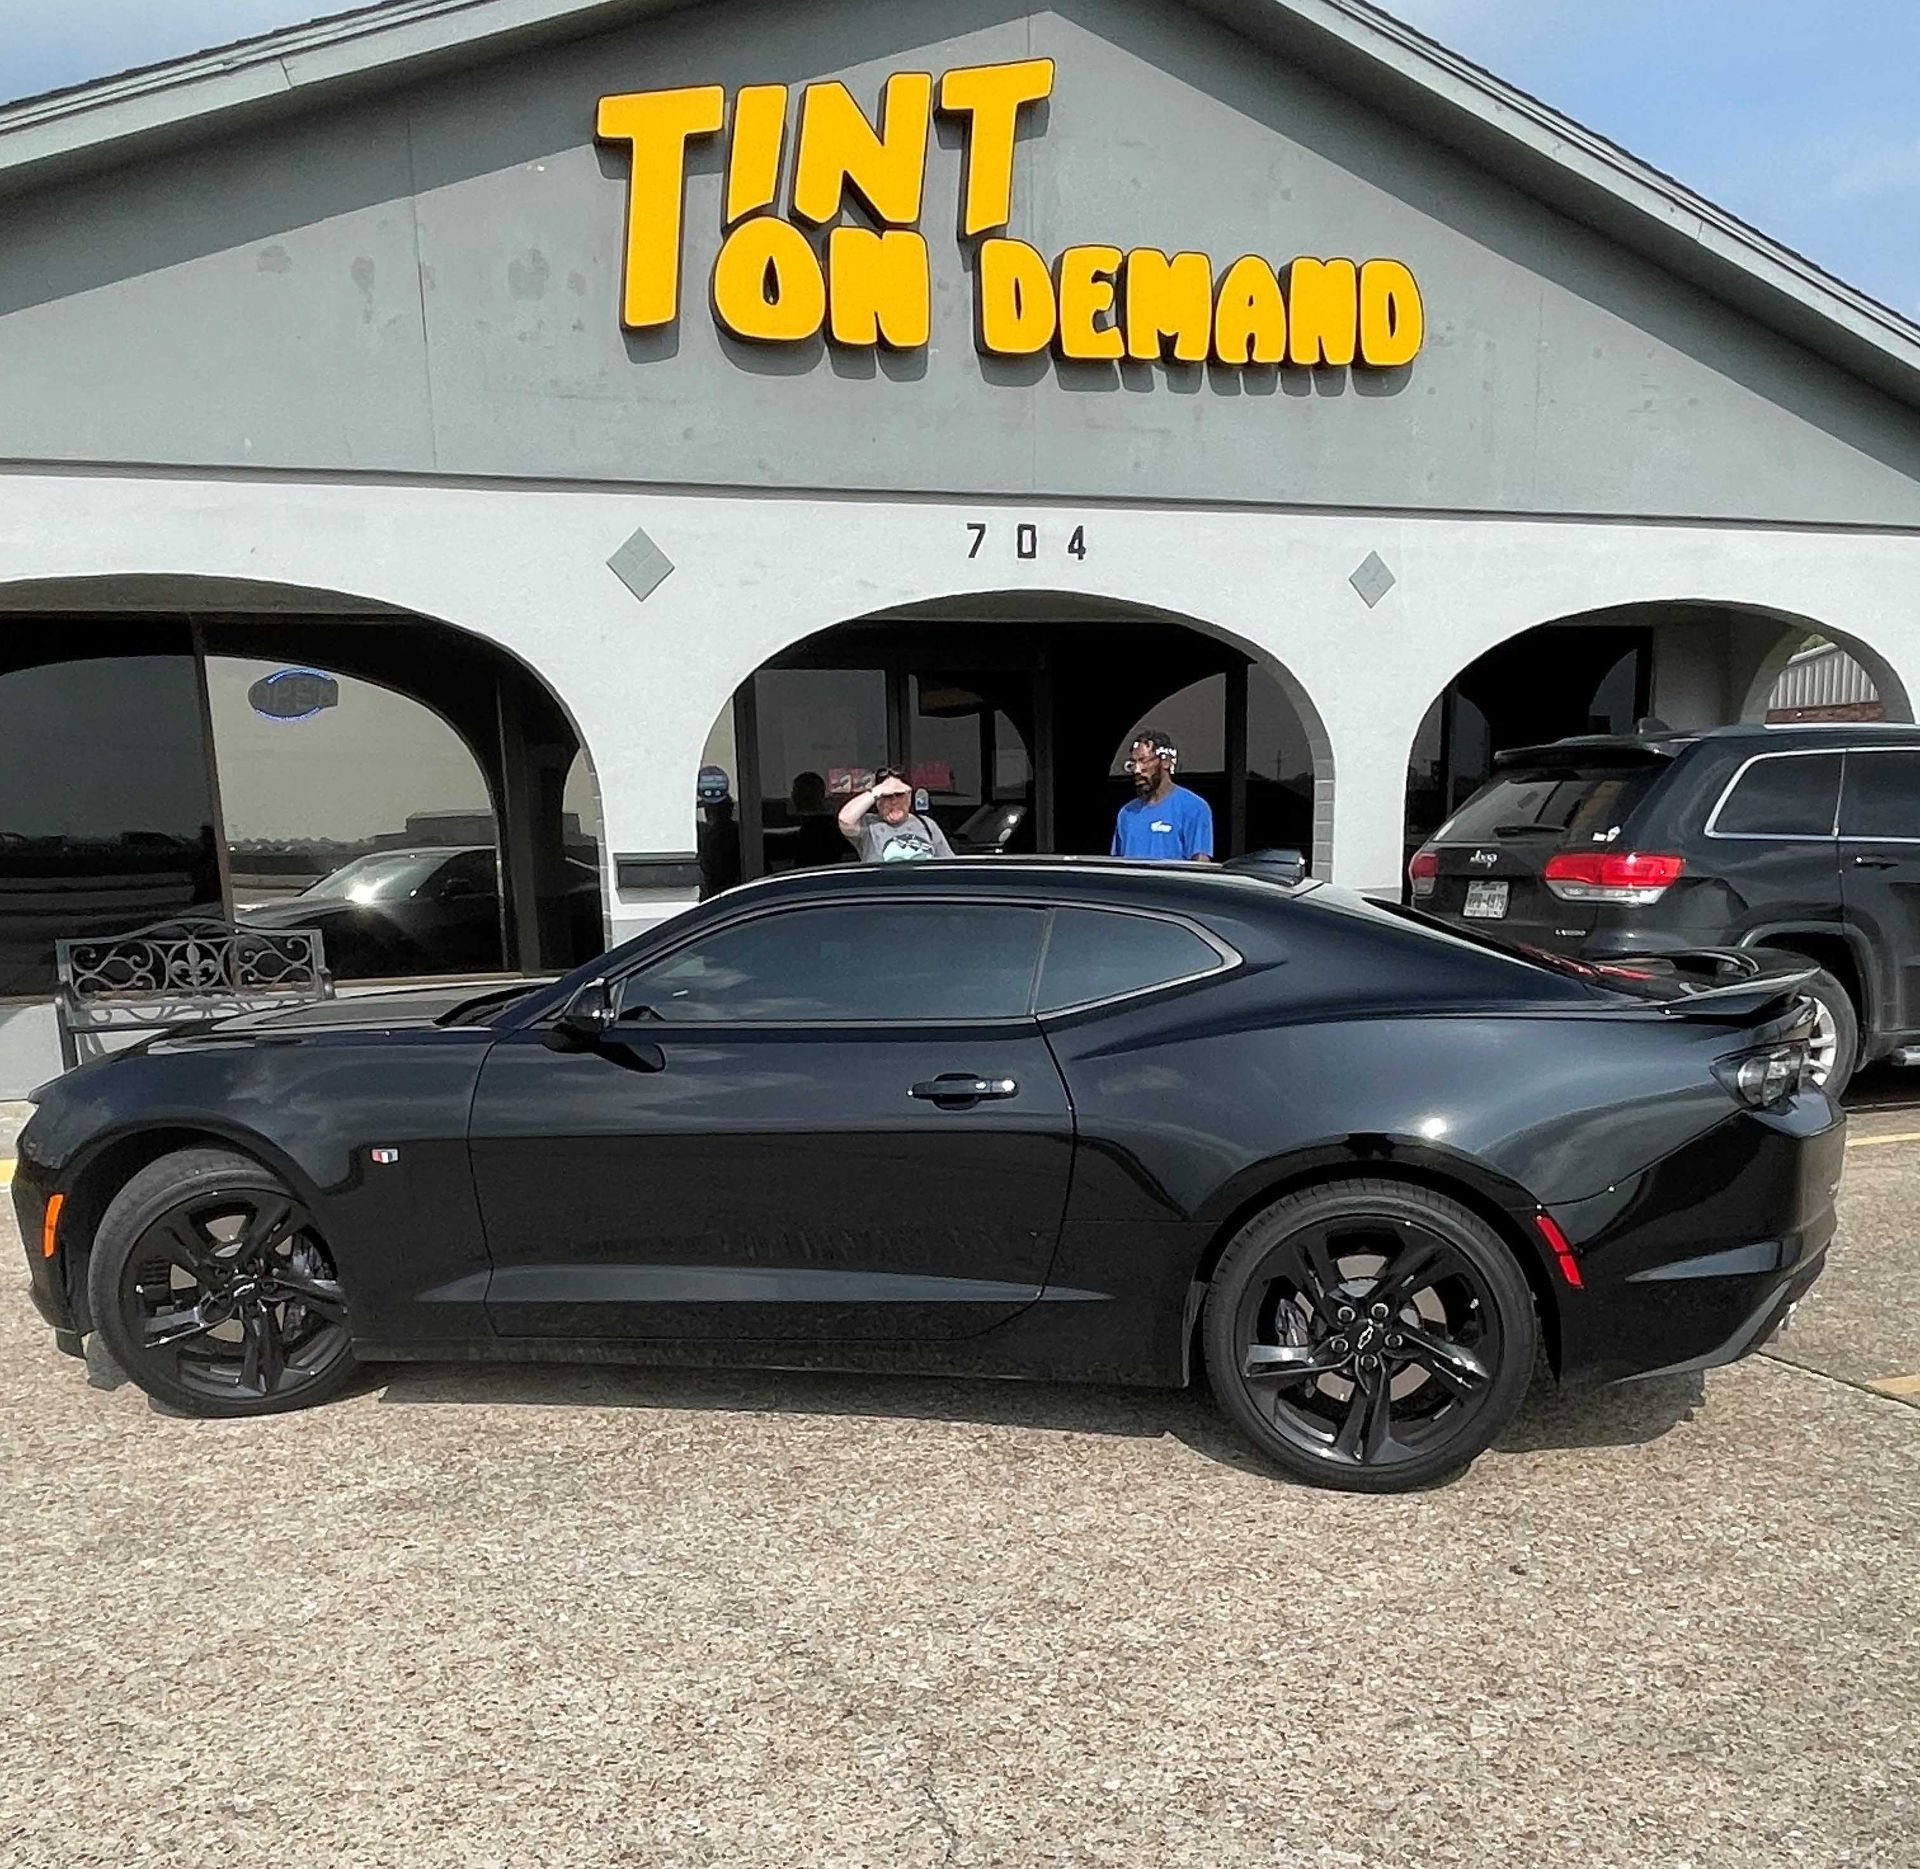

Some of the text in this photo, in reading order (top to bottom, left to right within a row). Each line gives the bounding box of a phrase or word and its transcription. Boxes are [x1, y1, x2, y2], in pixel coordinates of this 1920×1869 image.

[597, 57, 1055, 330] TINT
[713, 216, 1426, 371] ON DEMAND
